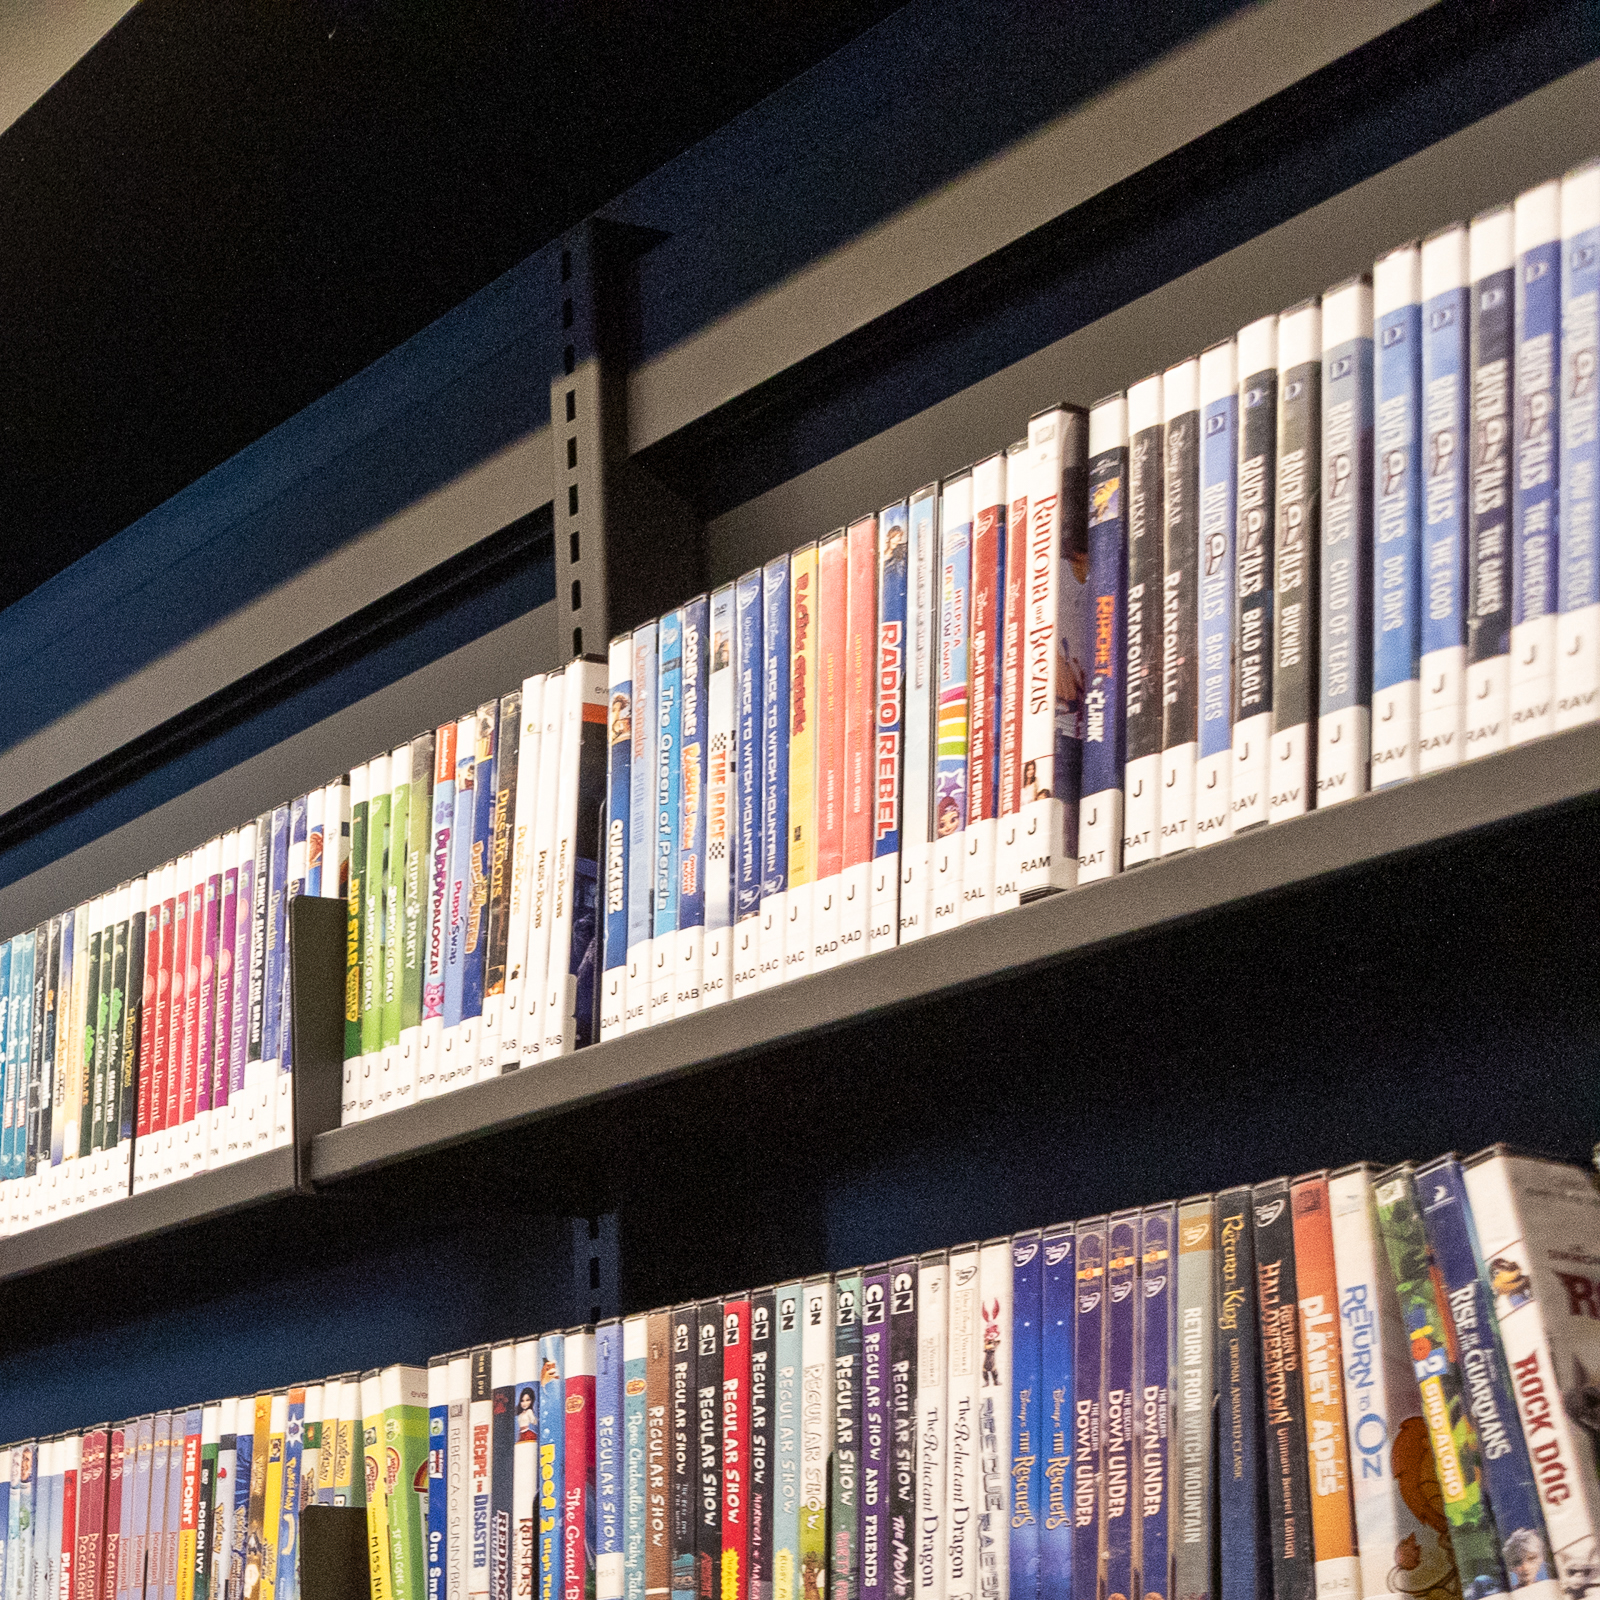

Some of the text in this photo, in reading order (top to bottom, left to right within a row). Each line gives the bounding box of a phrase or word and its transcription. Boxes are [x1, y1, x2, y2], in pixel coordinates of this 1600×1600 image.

[1028, 493, 1058, 715] Ramona Beezus
[1126, 584, 1146, 718] RATATOUILLE
[1163, 572, 1182, 707] RATATOUILLE
[1280, 603, 1301, 669] BUKWAS
[1327, 558, 1350, 698] CHILD TEARS
[1475, 561, 1502, 617] GAMES
[1240, 607, 1261, 708] BALD EAGLE
[708, 750, 726, 841] THE RACE
[876, 620, 902, 840] RADIO REBEL
[656, 685, 675, 911] The Queen Persia
[1198, 814, 1226, 834] RAV
[405, 850, 418, 970] PUPPY PARTY
[608, 819, 624, 915] QUACKERZ
[347, 917, 359, 966] STAR
[1258, 1259, 1293, 1426] HALLOWEENTOWN
[1299, 1294, 1334, 1412] PLANET
[1340, 1284, 1374, 1390] RETURN
[1449, 1283, 1512, 1461] RISE GUARDIANS
[183, 1440, 197, 1525] THE POINT
[452, 1427, 461, 1494] REBECCA
[599, 1415, 616, 1554] REGULAR SHOW
[648, 1406, 665, 1548] REGULAR SHOW
[674, 1362, 687, 1476] REGULAR SHOW
[699, 1386, 717, 1527] REGULAR SHOW
[723, 1378, 741, 1526] REGULAR SHOW
[752, 1351, 768, 1485] REGULAR SHOW
[778, 1366, 796, 1515] REGULAR SHOW
[836, 1355, 854, 1506] REGULAR SHOW
[864, 1332, 882, 1588] REGULAR SHOW AND FRIENDS
[891, 1359, 911, 1502] REGULAR SHOW
[1075, 1399, 1094, 1528] DOWN UNDER
[1108, 1389, 1127, 1519] DOWN UNDER
[1143, 1385, 1163, 1518] DOWN UNDER
[1182, 1306, 1203, 1544] RETURN FROM WITCH MOUNTAIN
[1513, 1349, 1571, 1506] ROCK DOG
[198, 1500, 207, 1546] POISON
[430, 1530, 442, 1564] One
[473, 1424, 489, 1568] RECIPE DISASTER
[539, 1516, 556, 1534] 2
[564, 1526, 582, 1584] Grand
[566, 1488, 582, 1523] The
[918, 1433, 939, 1589] Reluctant Dragon
[948, 1423, 971, 1580] Reluctant Dragon
